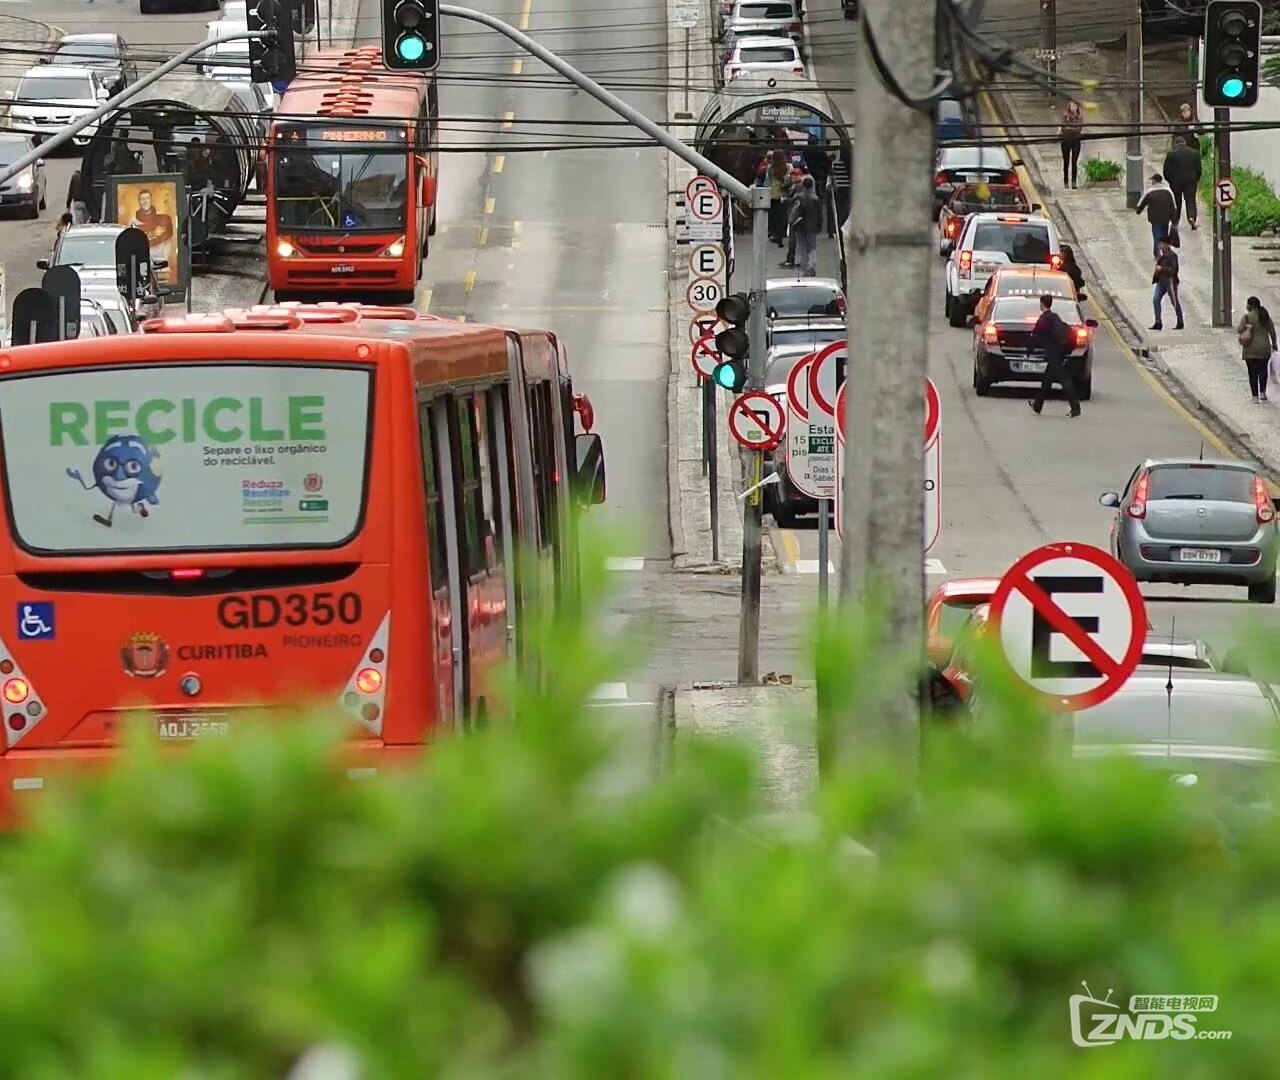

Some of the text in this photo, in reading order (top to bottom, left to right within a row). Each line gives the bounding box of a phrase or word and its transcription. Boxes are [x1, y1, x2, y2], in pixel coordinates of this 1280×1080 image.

[762, 107, 795, 116] Entrada
[699, 195, 713, 215] E
[700, 250, 715, 272] E
[693, 285, 717, 301] 30
[48, 395, 327, 447] RECICLE
[794, 435, 807, 445] 15
[203, 445, 242, 456] Separe
[254, 445, 275, 454] lixo
[277, 443, 327, 456] orgânico
[203, 456, 219, 466] do
[216, 591, 362, 630] GD350
[1030, 576, 1105, 679] E
[282, 633, 362, 648] PIONEIRO
[176, 643, 268, 661] CURITIBA
